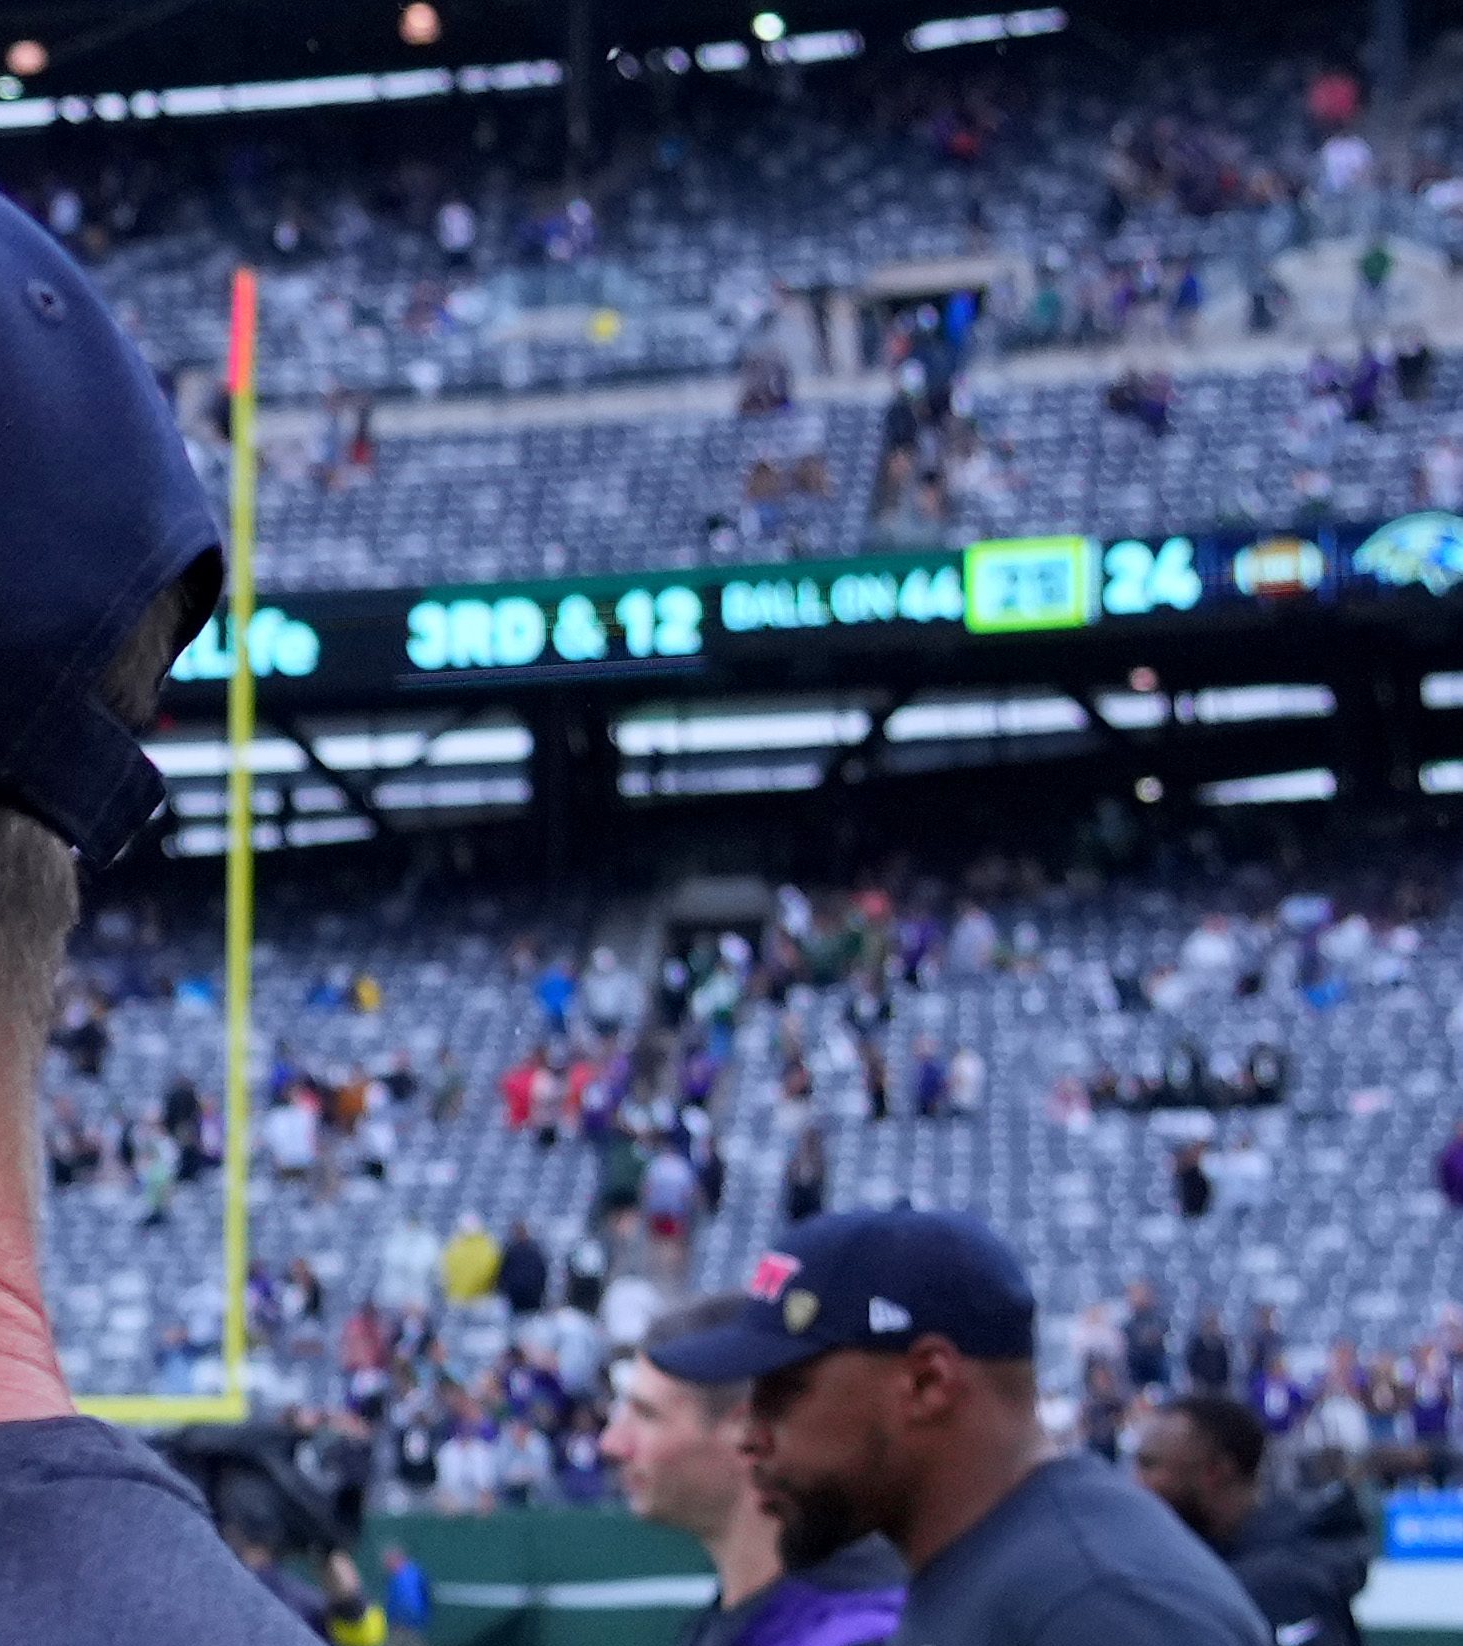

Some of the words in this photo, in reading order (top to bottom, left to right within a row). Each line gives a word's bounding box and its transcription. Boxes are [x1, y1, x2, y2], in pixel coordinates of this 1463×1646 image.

[1102, 536, 1202, 615] 24
[407, 597, 546, 671] 3RD
[553, 594, 609, 662] &
[615, 585, 703, 658] 12
